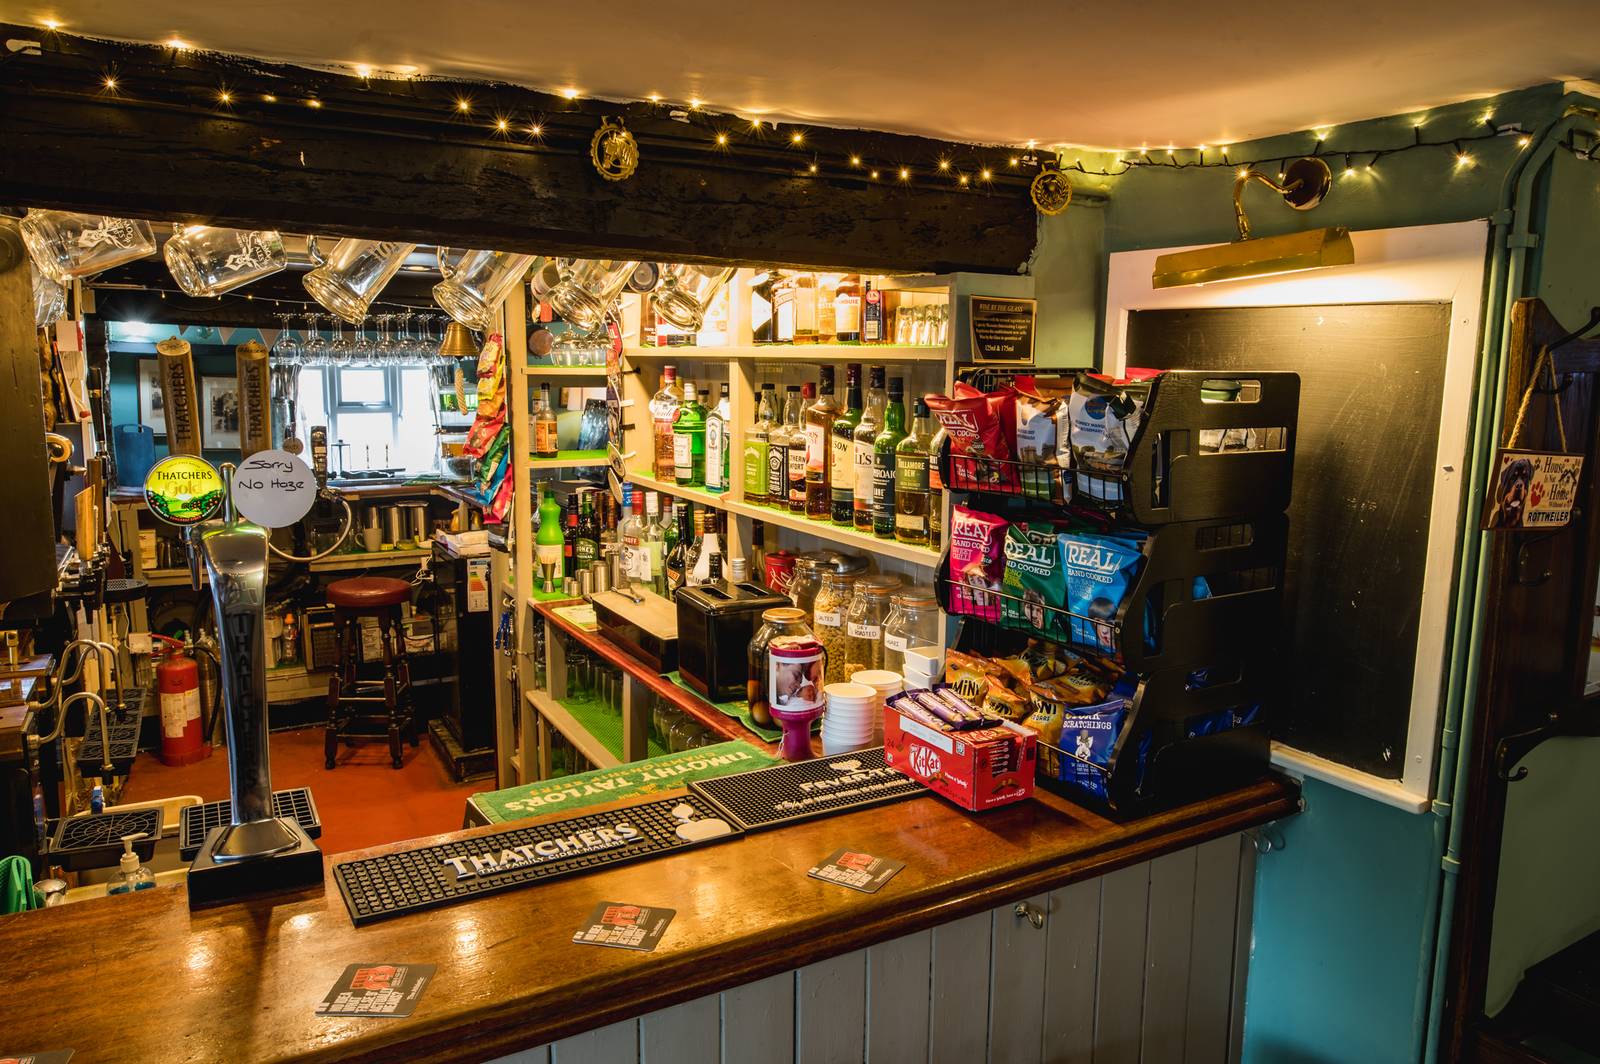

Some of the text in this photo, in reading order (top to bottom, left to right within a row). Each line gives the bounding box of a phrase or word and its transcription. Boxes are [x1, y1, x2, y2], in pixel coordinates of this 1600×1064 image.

[169, 363, 191, 443] THATCHERS
[246, 364, 262, 440] THATCHERS
[244, 460, 294, 473] Sorry
[897, 459, 925, 470] TULLAMORE
[1544, 457, 1565, 473] House
[156, 471, 213, 480] THATCHERS
[165, 480, 202, 496] Gold
[238, 479, 305, 491] No Haze
[1550, 484, 1569, 500] Home
[1528, 512, 1569, 522] ROTTWEILER
[1068, 545, 1114, 570] REAL
[1018, 564, 1051, 576] COOKED
[1068, 568, 1113, 583] HAND COOKED
[1062, 721, 1112, 730] SCRATCHINGS
[913, 749, 940, 777] KitKat
[504, 752, 753, 812] TIMOTHY TAYLOR'S
[443, 822, 645, 879] THATCHERS
[479, 864, 504, 875] THE
[505, 855, 545, 871] FAMILY
